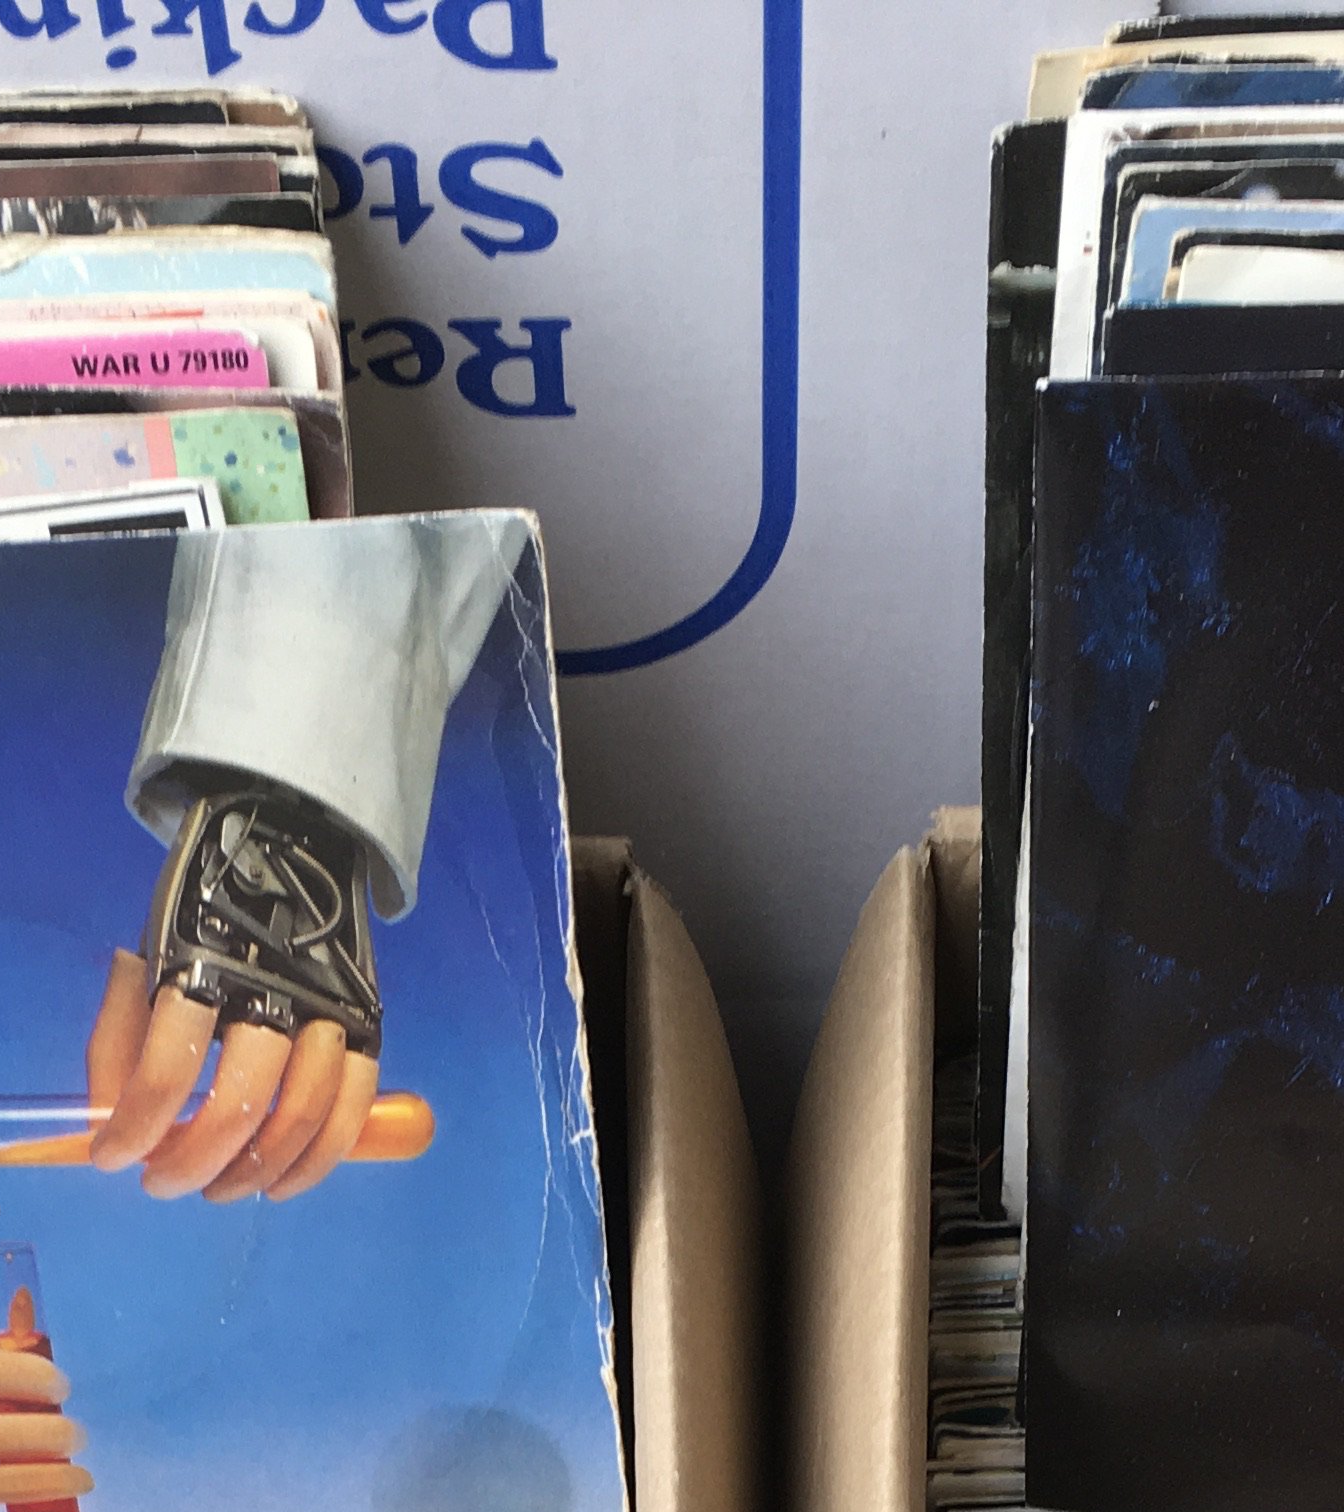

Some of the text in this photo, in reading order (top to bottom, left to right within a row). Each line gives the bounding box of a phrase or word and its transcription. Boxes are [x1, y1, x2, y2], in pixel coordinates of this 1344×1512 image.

[71, 349, 249, 377] WAR U 79180
[343, 317, 577, 418] Re
